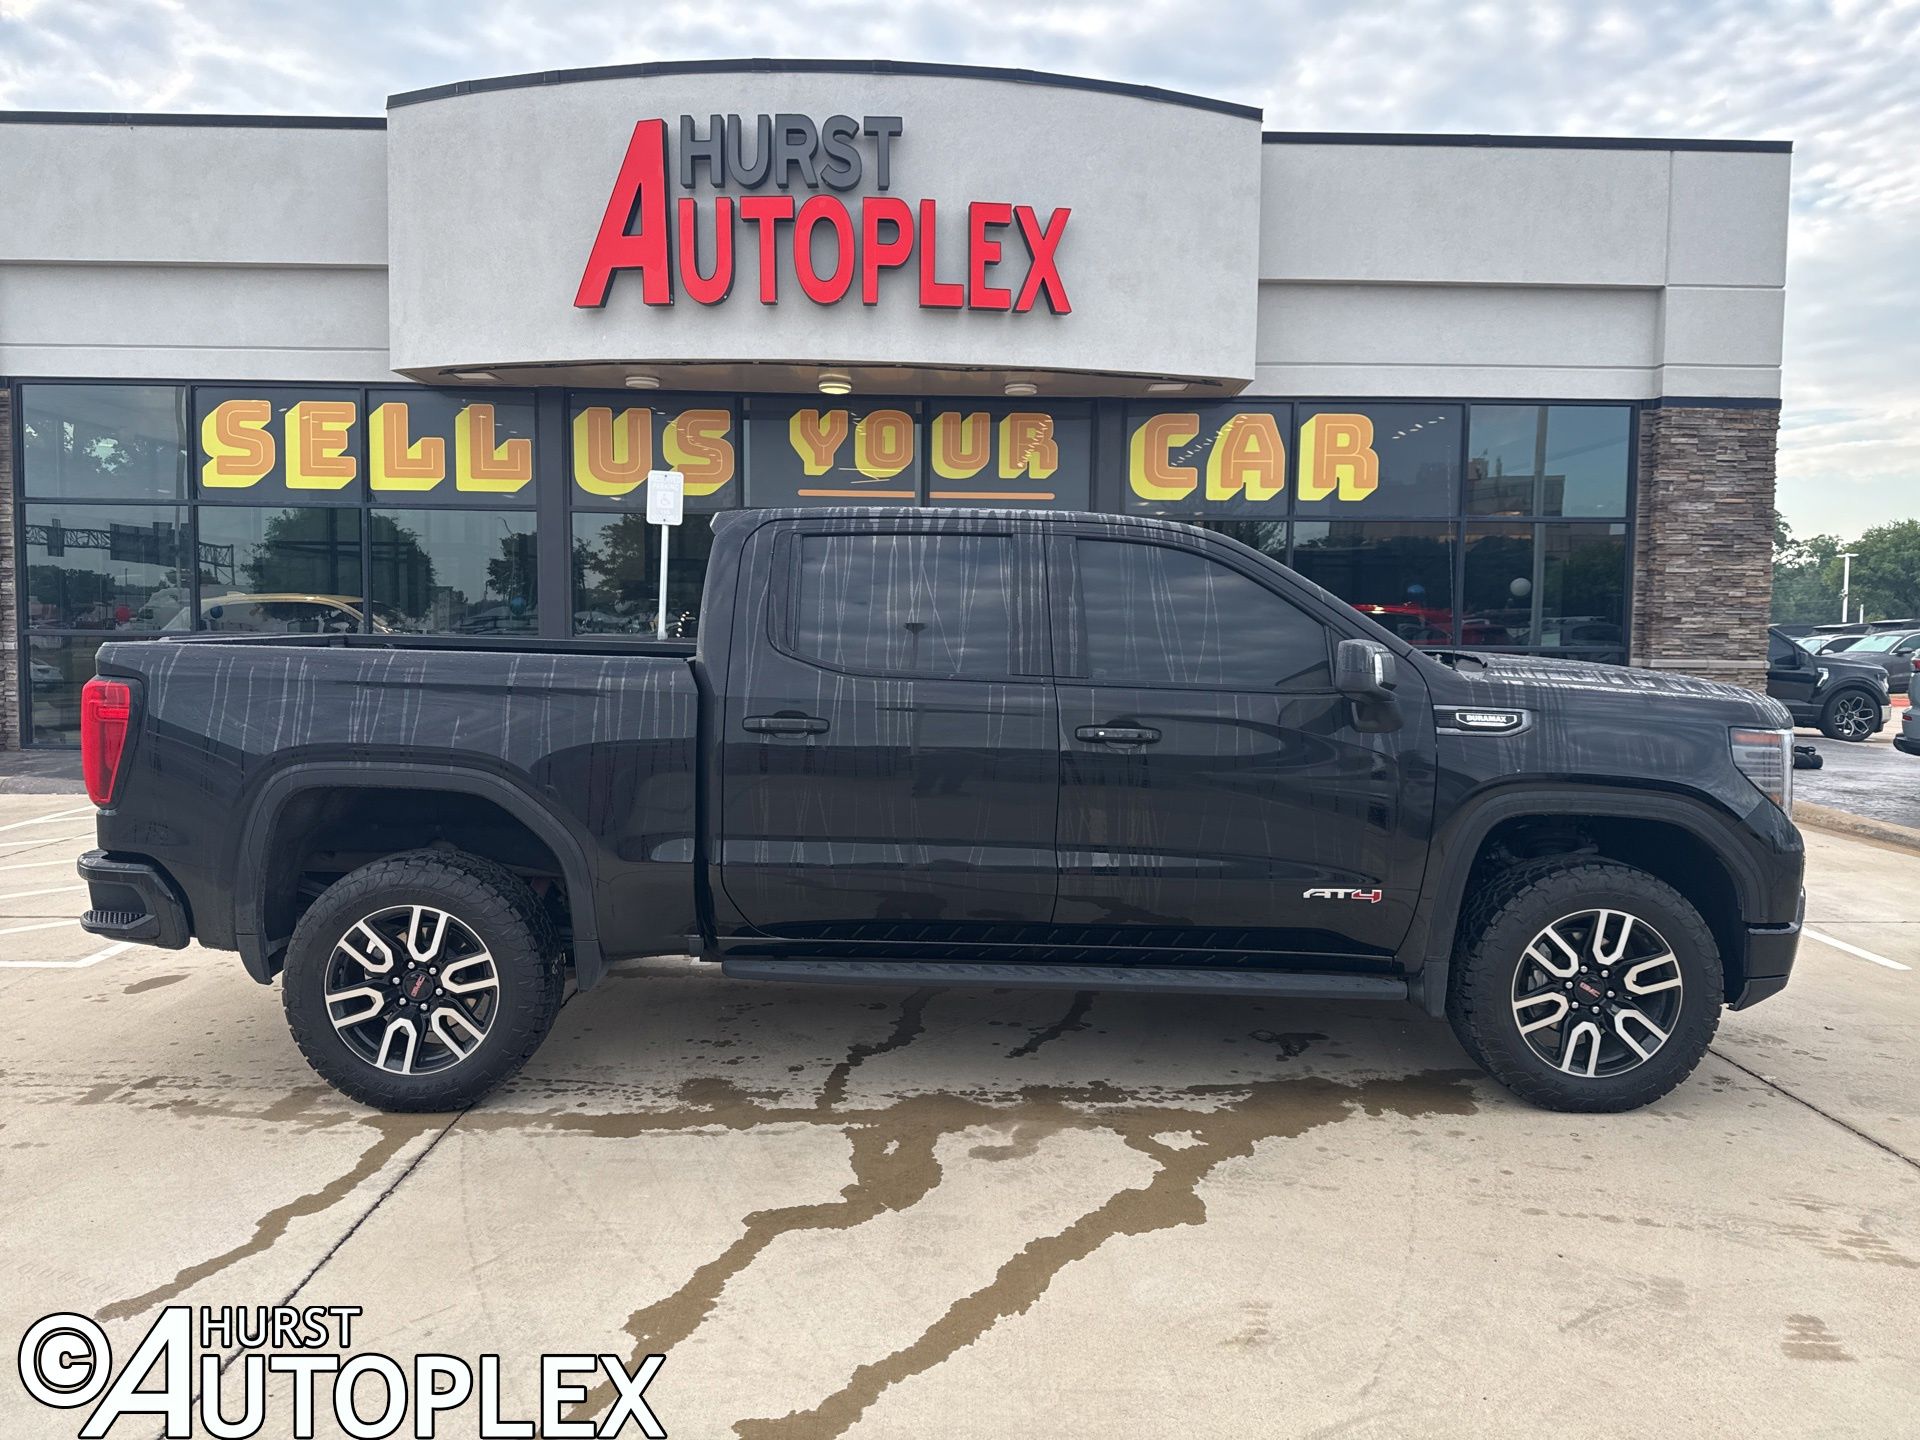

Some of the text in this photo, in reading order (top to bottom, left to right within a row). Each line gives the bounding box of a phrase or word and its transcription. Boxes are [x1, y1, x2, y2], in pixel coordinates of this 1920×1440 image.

[680, 114, 903, 191] HURST
[574, 118, 1072, 315] AUTOPLEX
[201, 399, 1380, 502] SELL US YOUR CAR
[1303, 888, 1382, 904] AT4
